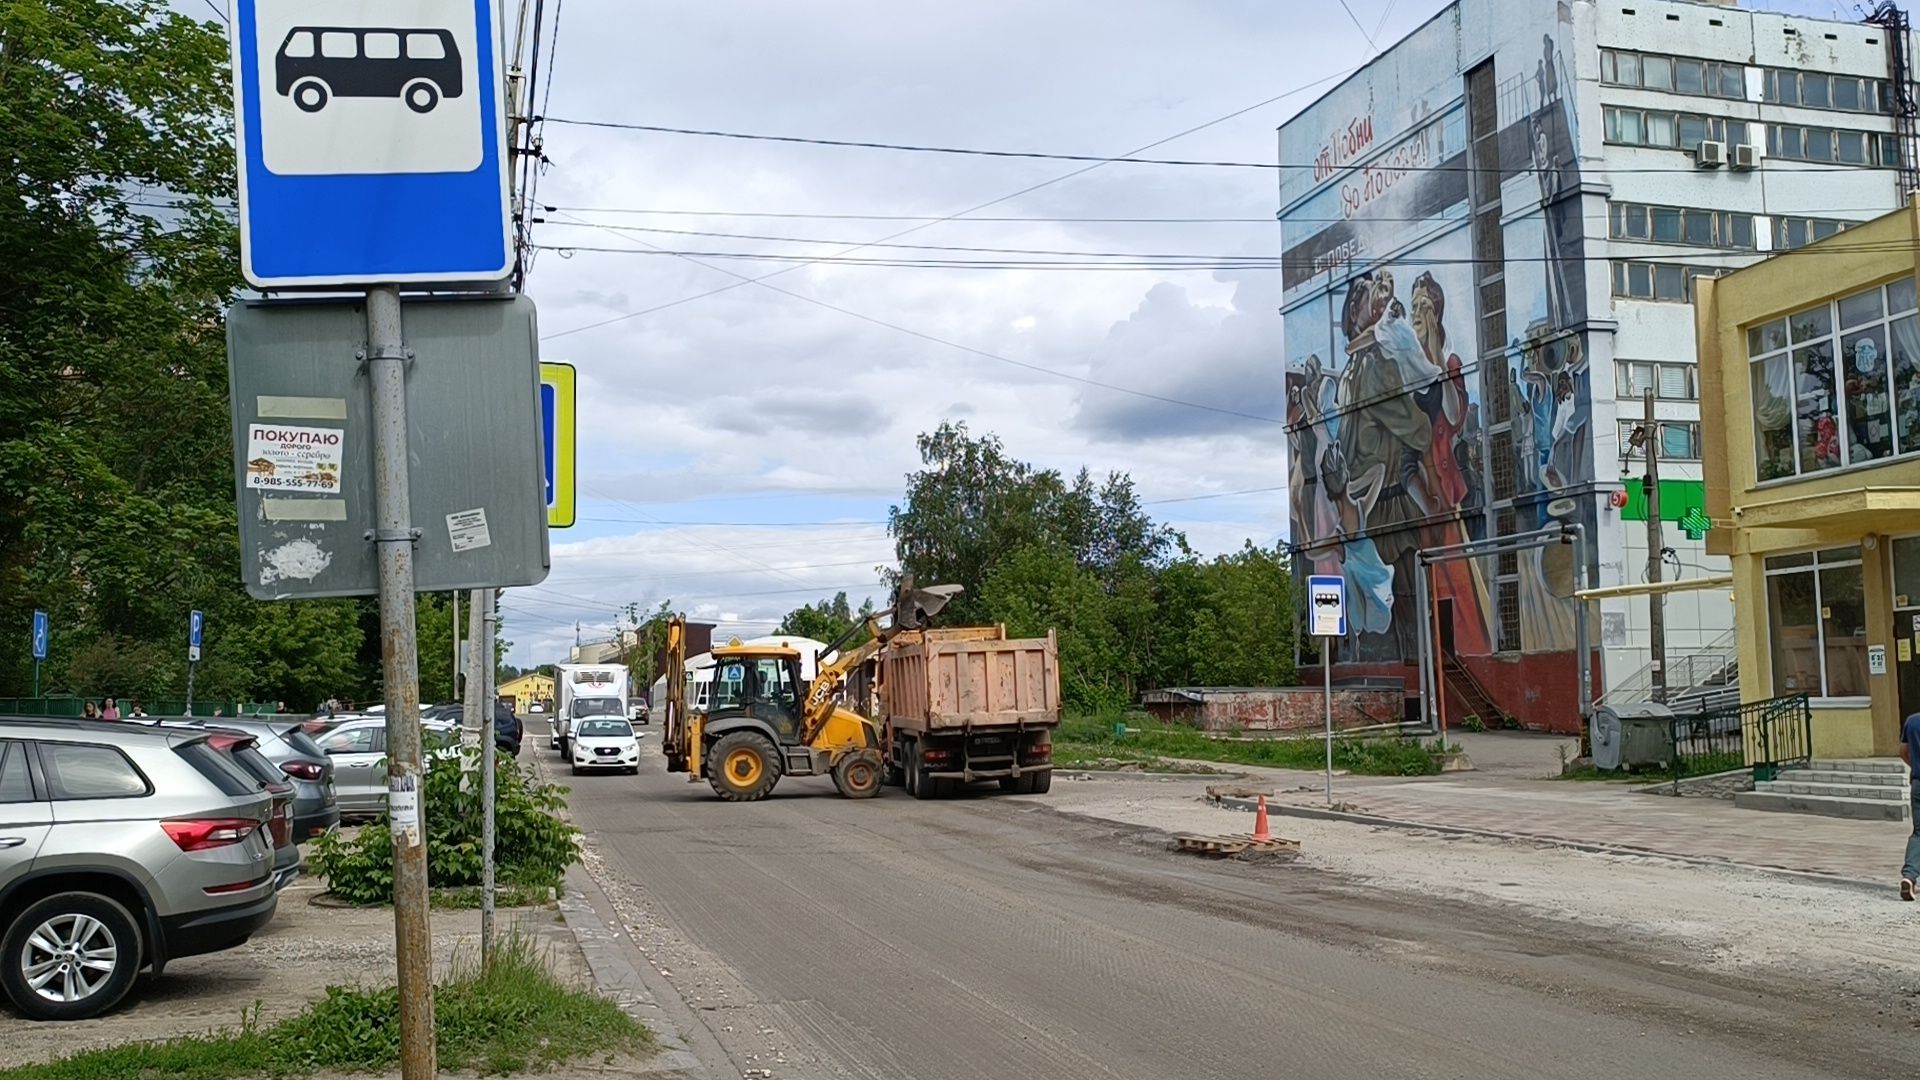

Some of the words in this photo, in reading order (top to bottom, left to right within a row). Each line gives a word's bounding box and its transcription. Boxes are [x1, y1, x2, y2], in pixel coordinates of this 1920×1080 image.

[253, 429, 339, 445] ПОКУПАЮ
[193, 614, 200, 641] P
[812, 681, 830, 705] JCB
